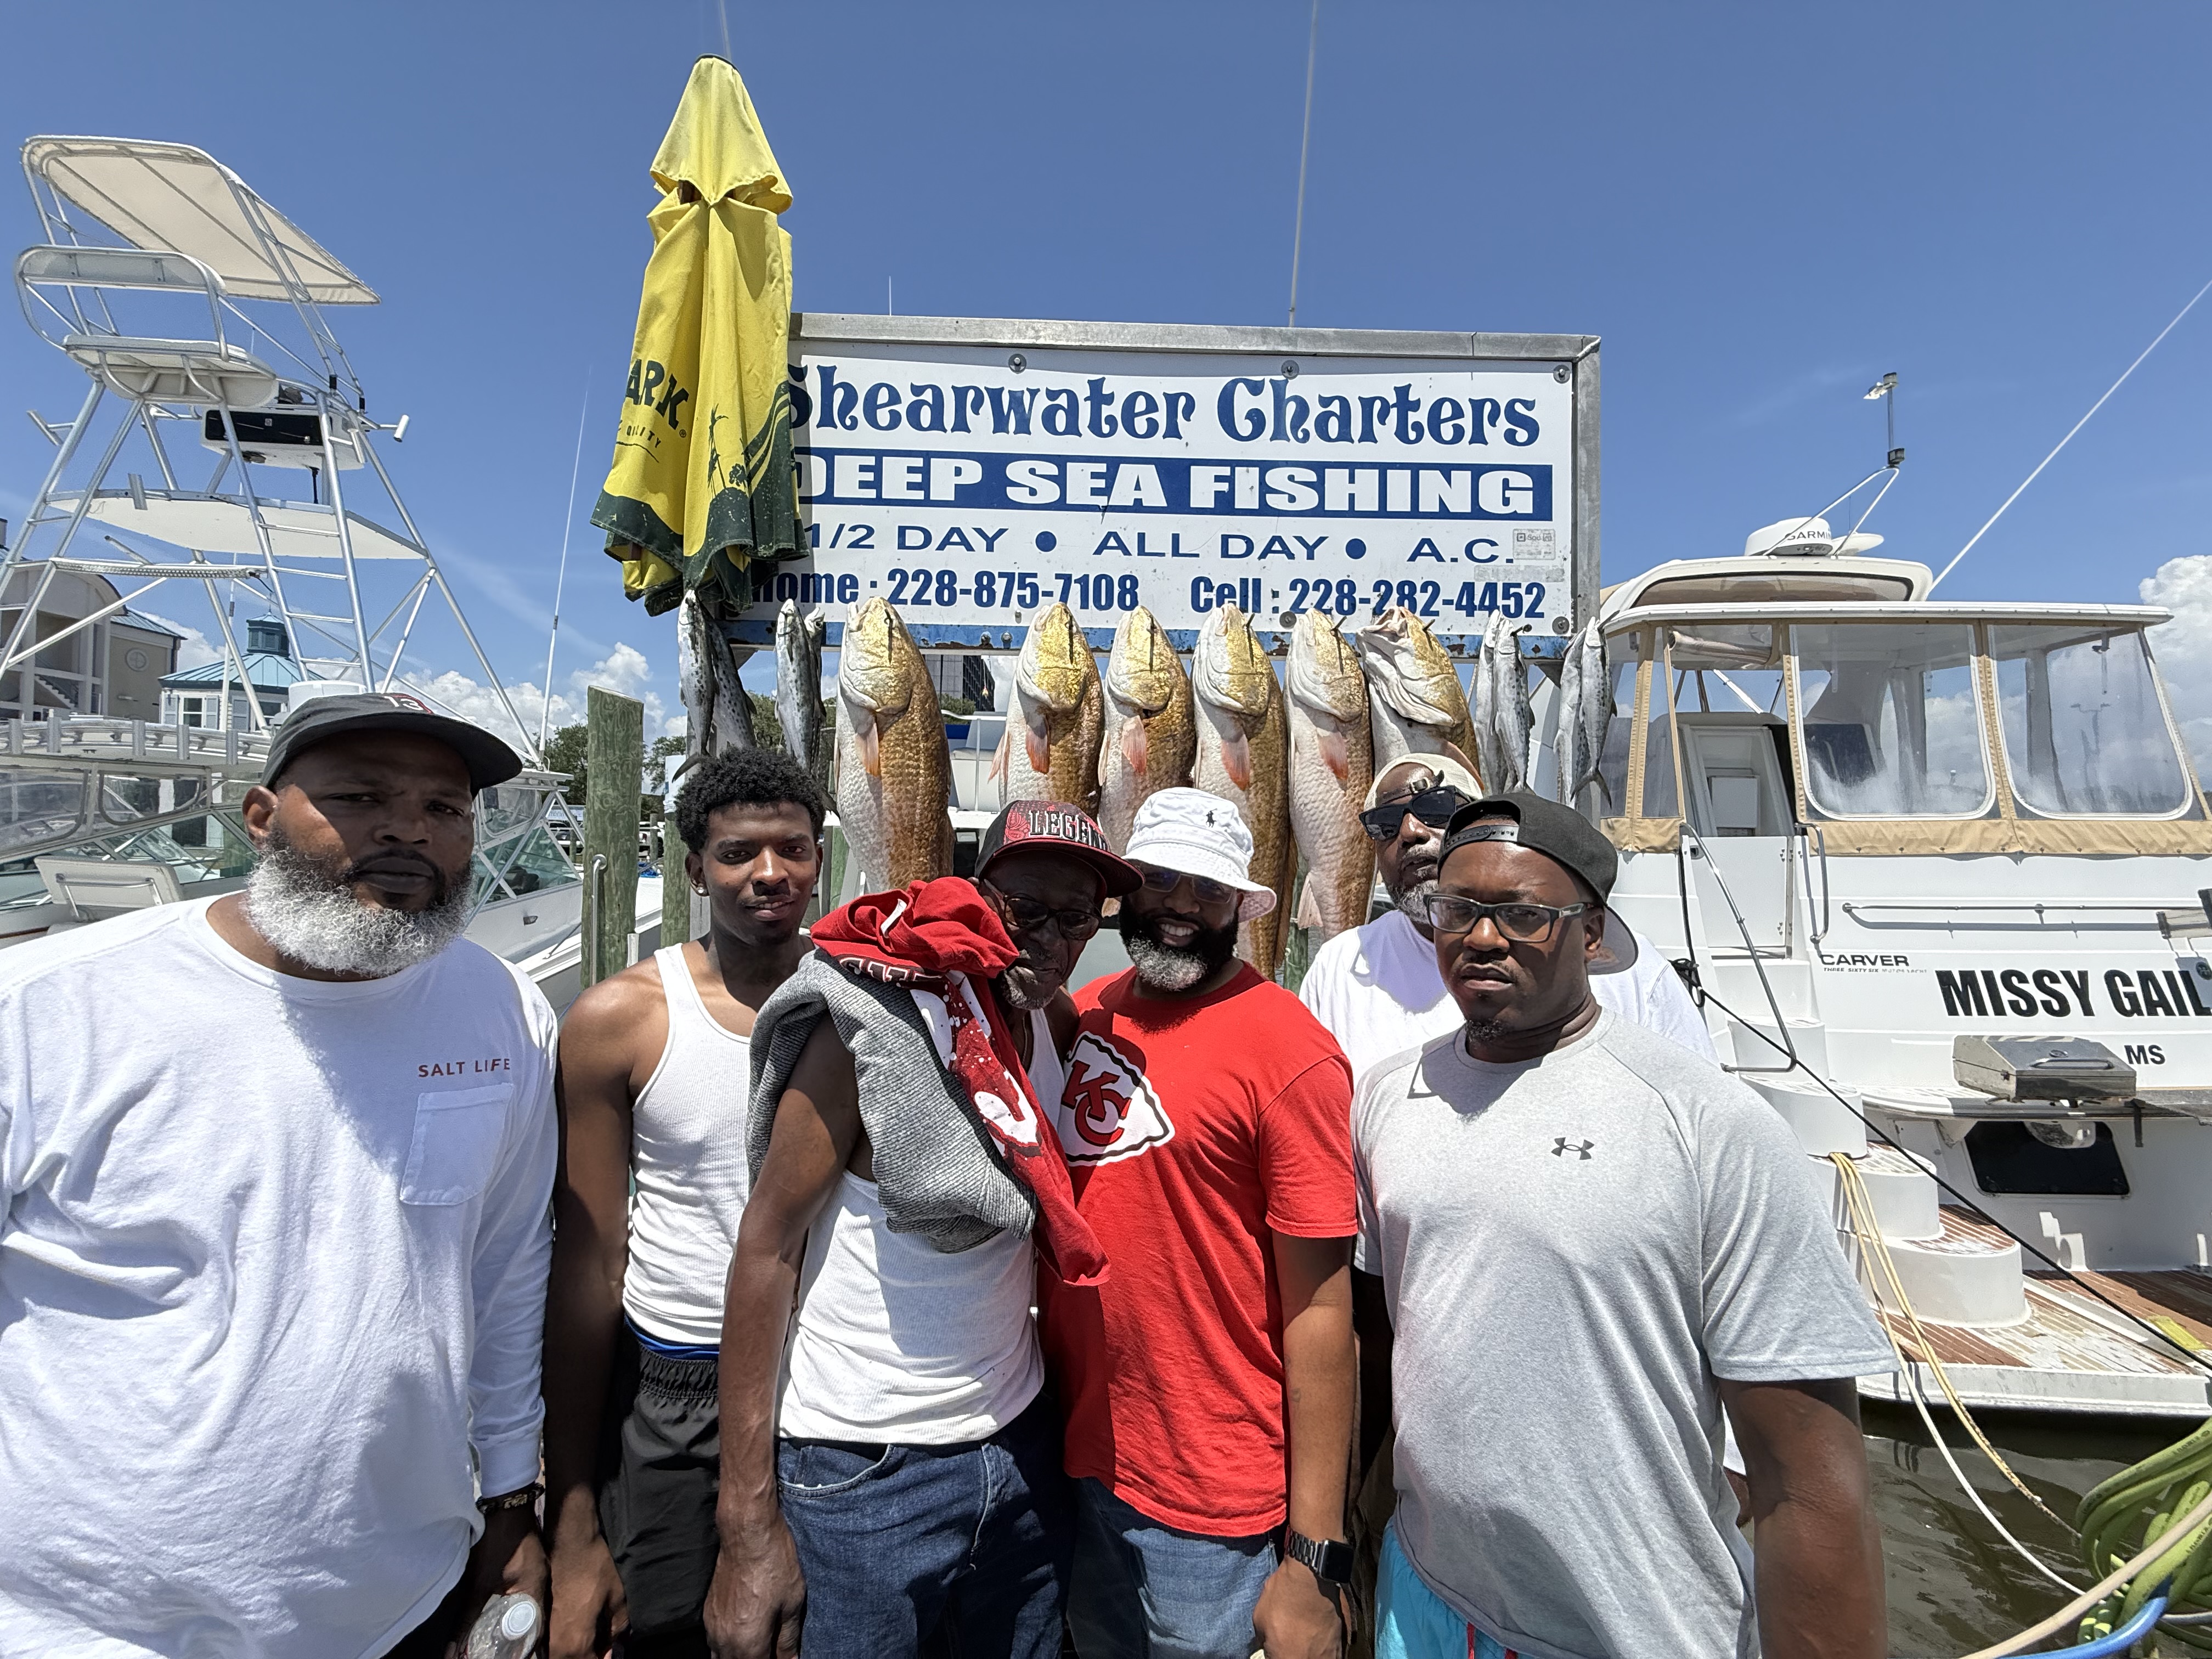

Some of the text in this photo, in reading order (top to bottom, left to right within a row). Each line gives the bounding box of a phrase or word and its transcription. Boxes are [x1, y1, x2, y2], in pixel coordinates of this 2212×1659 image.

[1217, 377, 1541, 447] Charters
[798, 454, 1534, 515] DEEP SEA FISHING
[805, 523, 875, 549] 1/2
[897, 525, 1008, 552] DAY
[1092, 531, 1200, 558] ALL
[1220, 534, 1329, 561] DAY
[1407, 538, 1514, 564] A.C.
[887, 568, 1139, 611] 228-875-7108
[1190, 576, 1262, 614] Cell
[1289, 578, 1545, 619] 228-282-4452
[1821, 954, 1910, 967] CARVER
[1935, 969, 2212, 1017] MISSY GAIL
[418, 1058, 511, 1077] SALT LIFE
[2124, 1044, 2166, 1065] MS
[1060, 1059, 1133, 1147] KC
